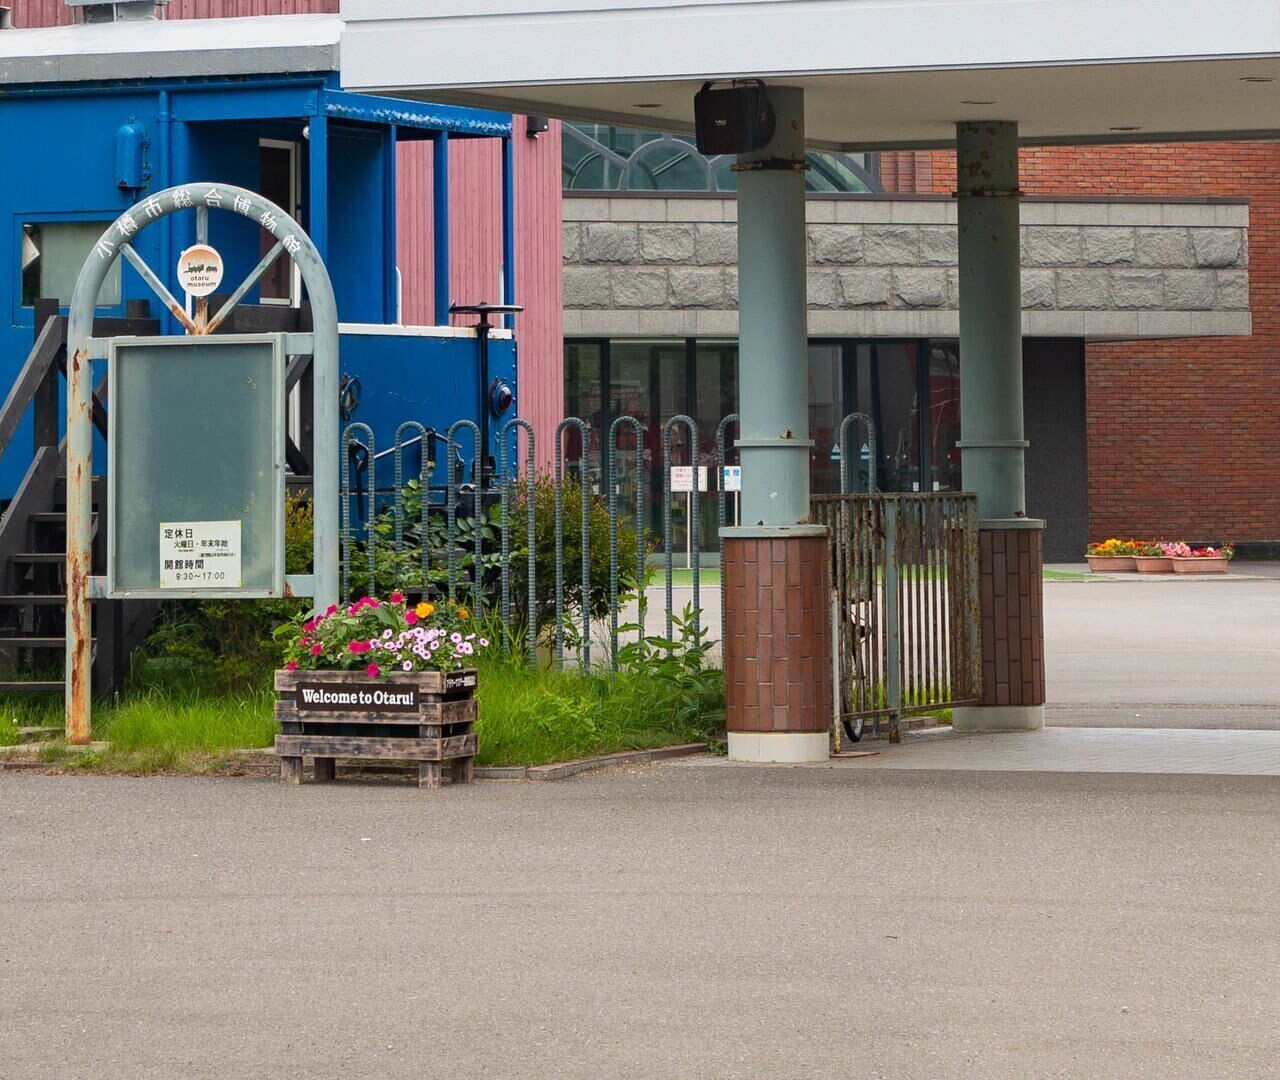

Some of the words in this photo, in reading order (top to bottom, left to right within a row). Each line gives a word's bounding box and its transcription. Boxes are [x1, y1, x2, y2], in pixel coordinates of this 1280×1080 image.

[96, 188, 301, 259] 小樽市総合博物館
[164, 528, 193, 539] 定休日
[164, 559, 204, 570] 開館時間
[302, 688, 357, 705] Welcome
[359, 690, 373, 706] to
[373, 690, 414, 707] Otaru!
